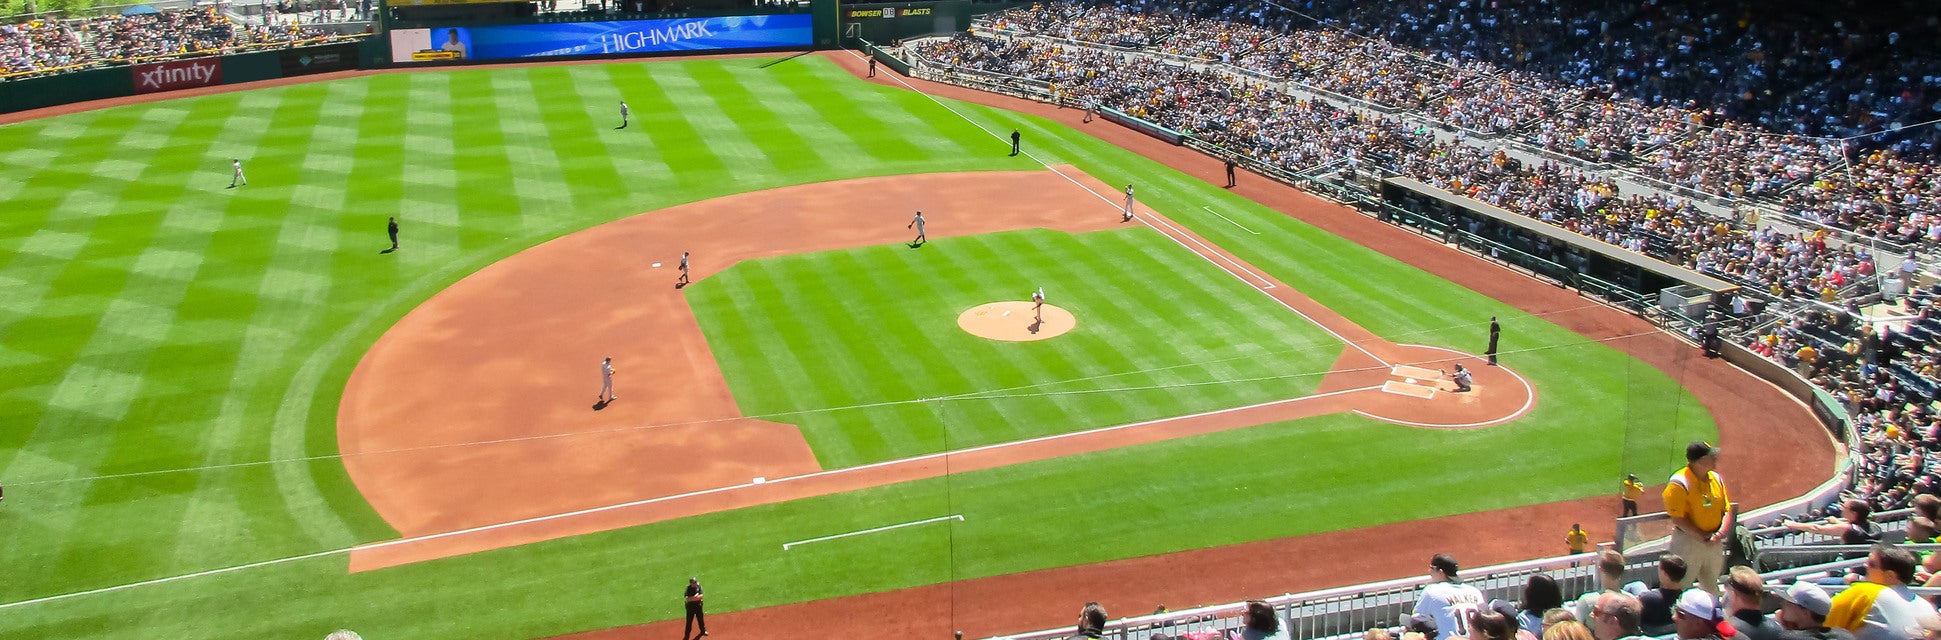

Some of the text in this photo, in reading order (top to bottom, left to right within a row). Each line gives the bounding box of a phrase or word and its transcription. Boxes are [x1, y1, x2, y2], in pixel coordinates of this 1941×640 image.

[903, 8, 931, 16] BLASTS
[602, 20, 712, 53] HIGHMARK
[141, 62, 216, 88] xfinity
[1446, 595, 1478, 606] WALKER
